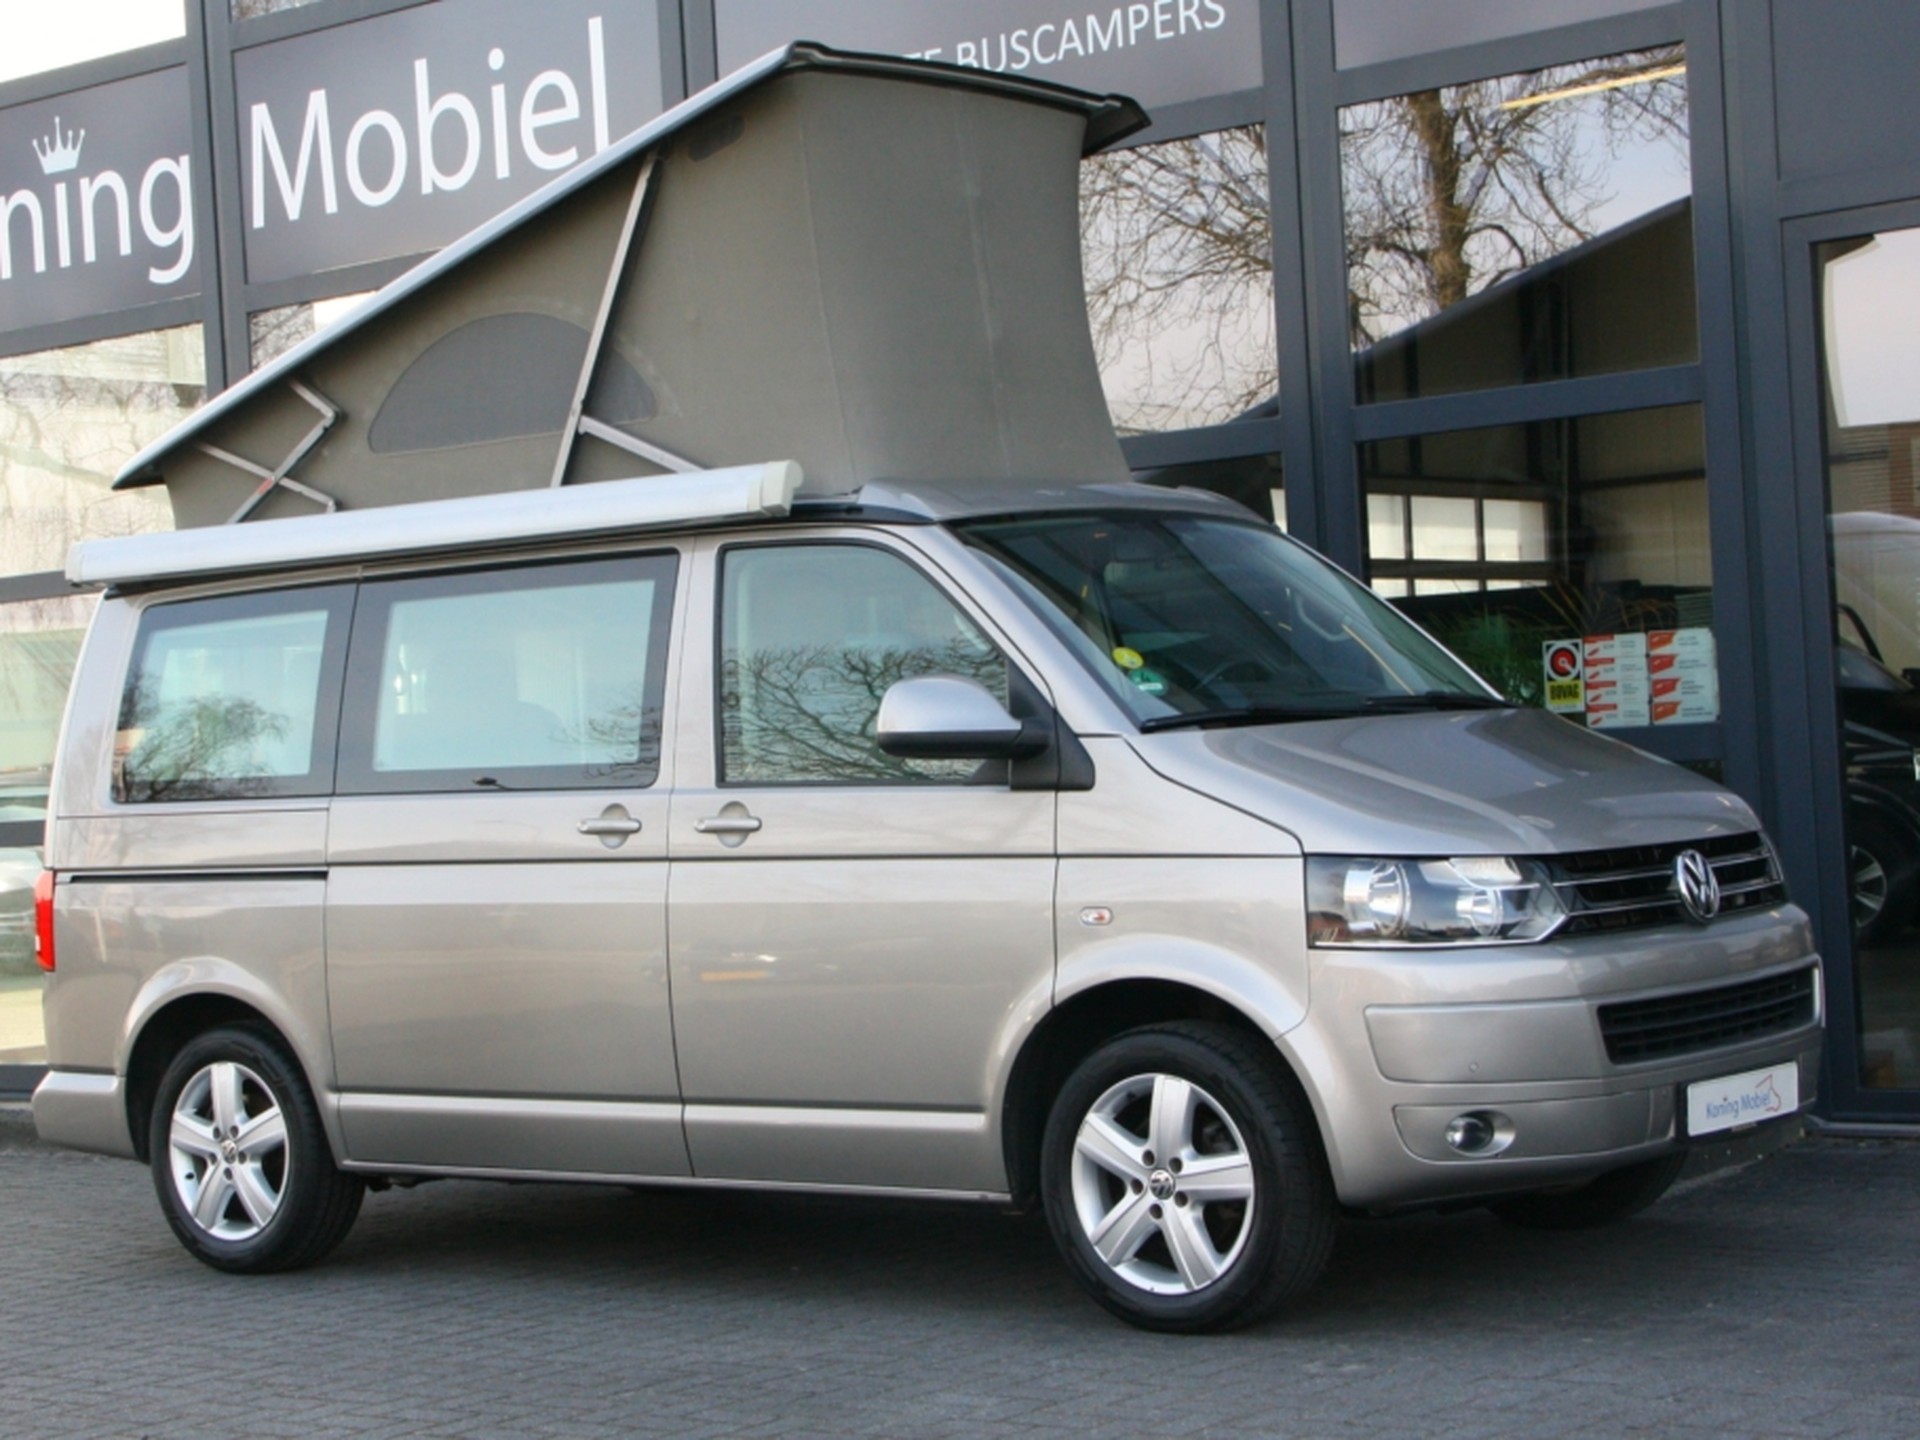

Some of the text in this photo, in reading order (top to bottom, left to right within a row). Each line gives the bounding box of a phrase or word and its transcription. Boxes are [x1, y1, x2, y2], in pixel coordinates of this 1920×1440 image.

[956, 0, 1226, 73] BUSCAMPERS
[250, 16, 609, 230] Mobiel
[1706, 1098, 1739, 1119] Koning
